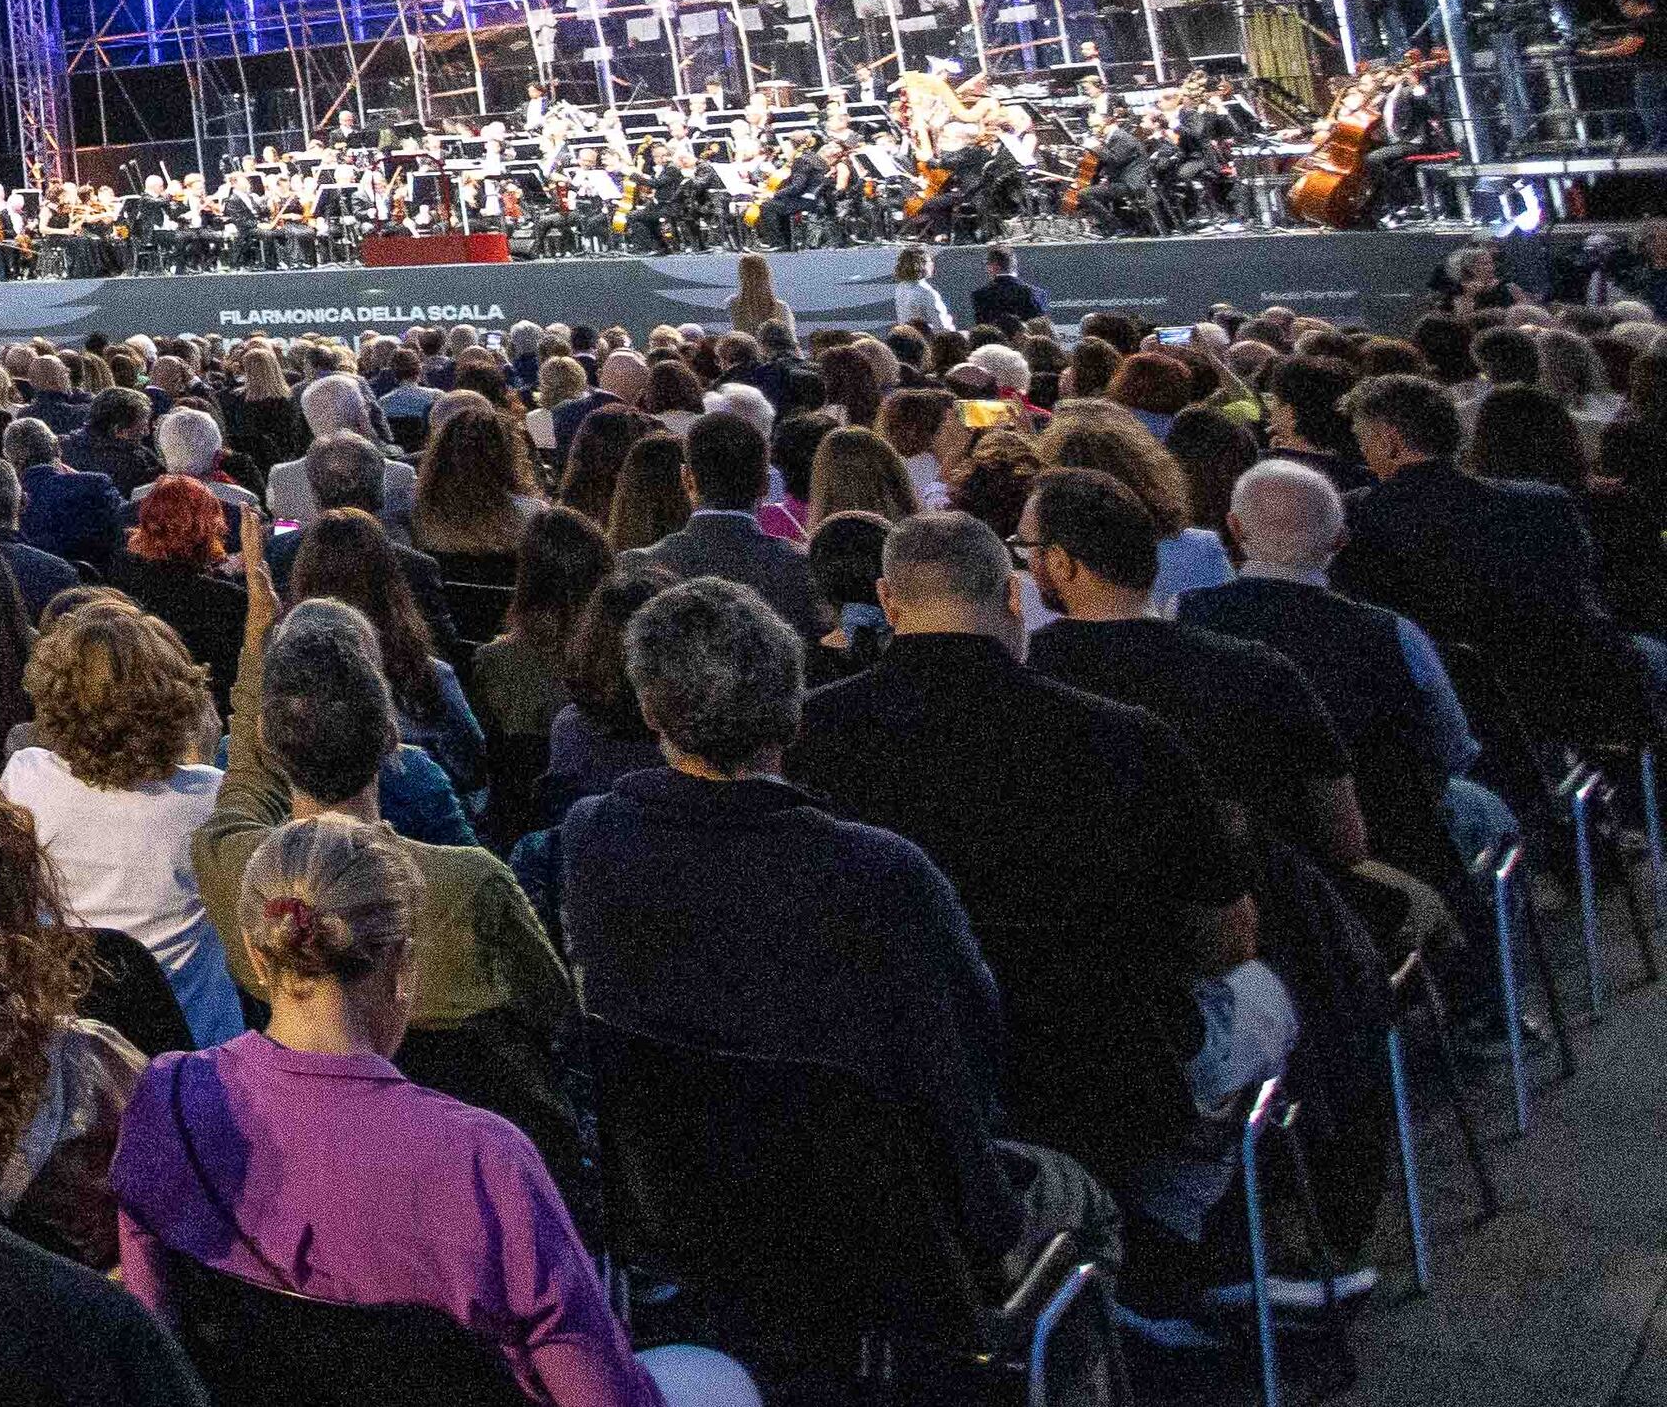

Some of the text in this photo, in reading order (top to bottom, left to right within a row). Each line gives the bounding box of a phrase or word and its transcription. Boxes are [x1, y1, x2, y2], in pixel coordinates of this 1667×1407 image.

[218, 304, 506, 325] FILARMONICA DELLA SCALA
